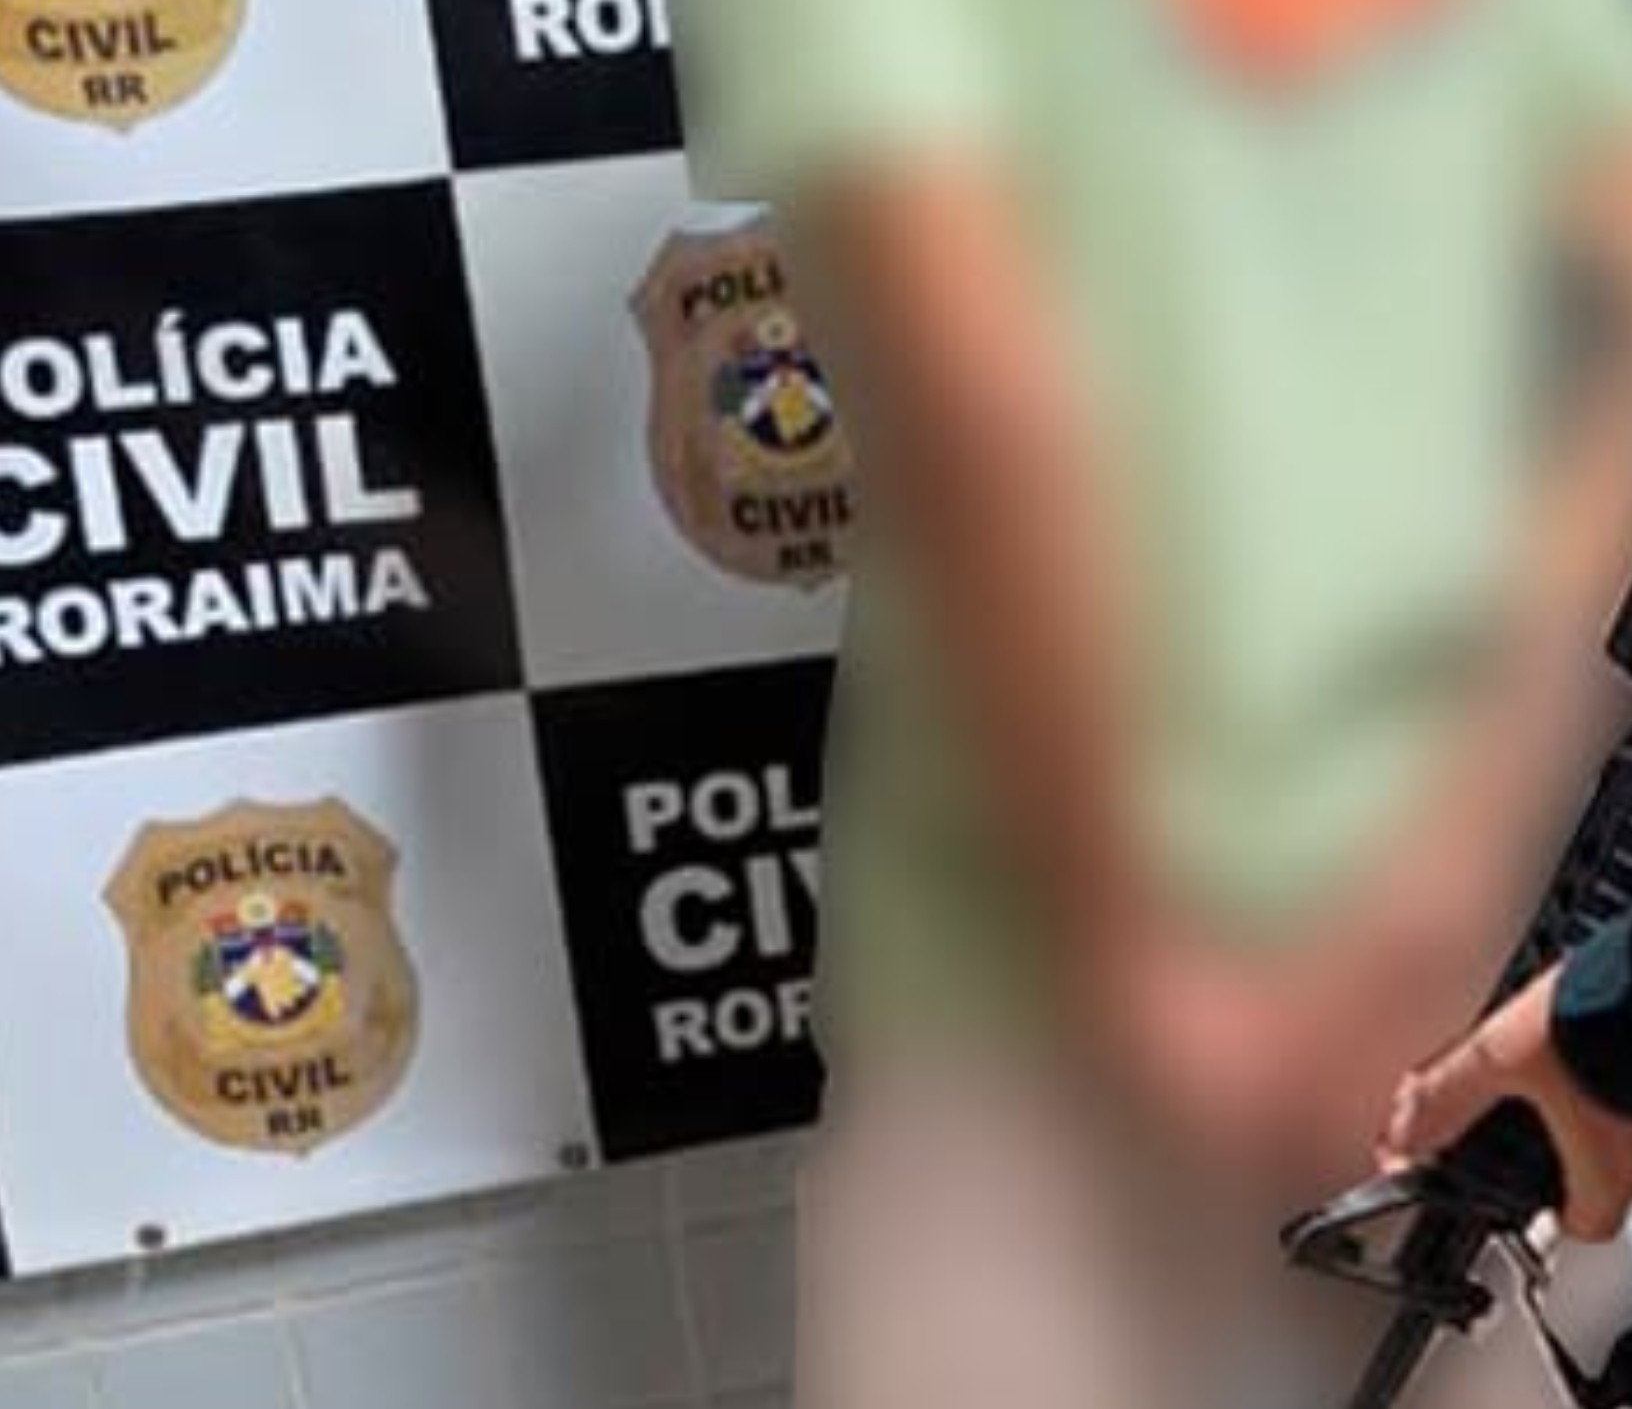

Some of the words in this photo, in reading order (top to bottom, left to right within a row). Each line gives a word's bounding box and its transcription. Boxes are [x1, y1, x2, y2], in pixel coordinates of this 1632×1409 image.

[26, 10, 176, 65] CIVIL
[82, 74, 148, 108] RR
[0, 412, 421, 566] CIVIL
[0, 547, 431, 668] RORAIMA
[214, 1056, 351, 1103] CIVIL
